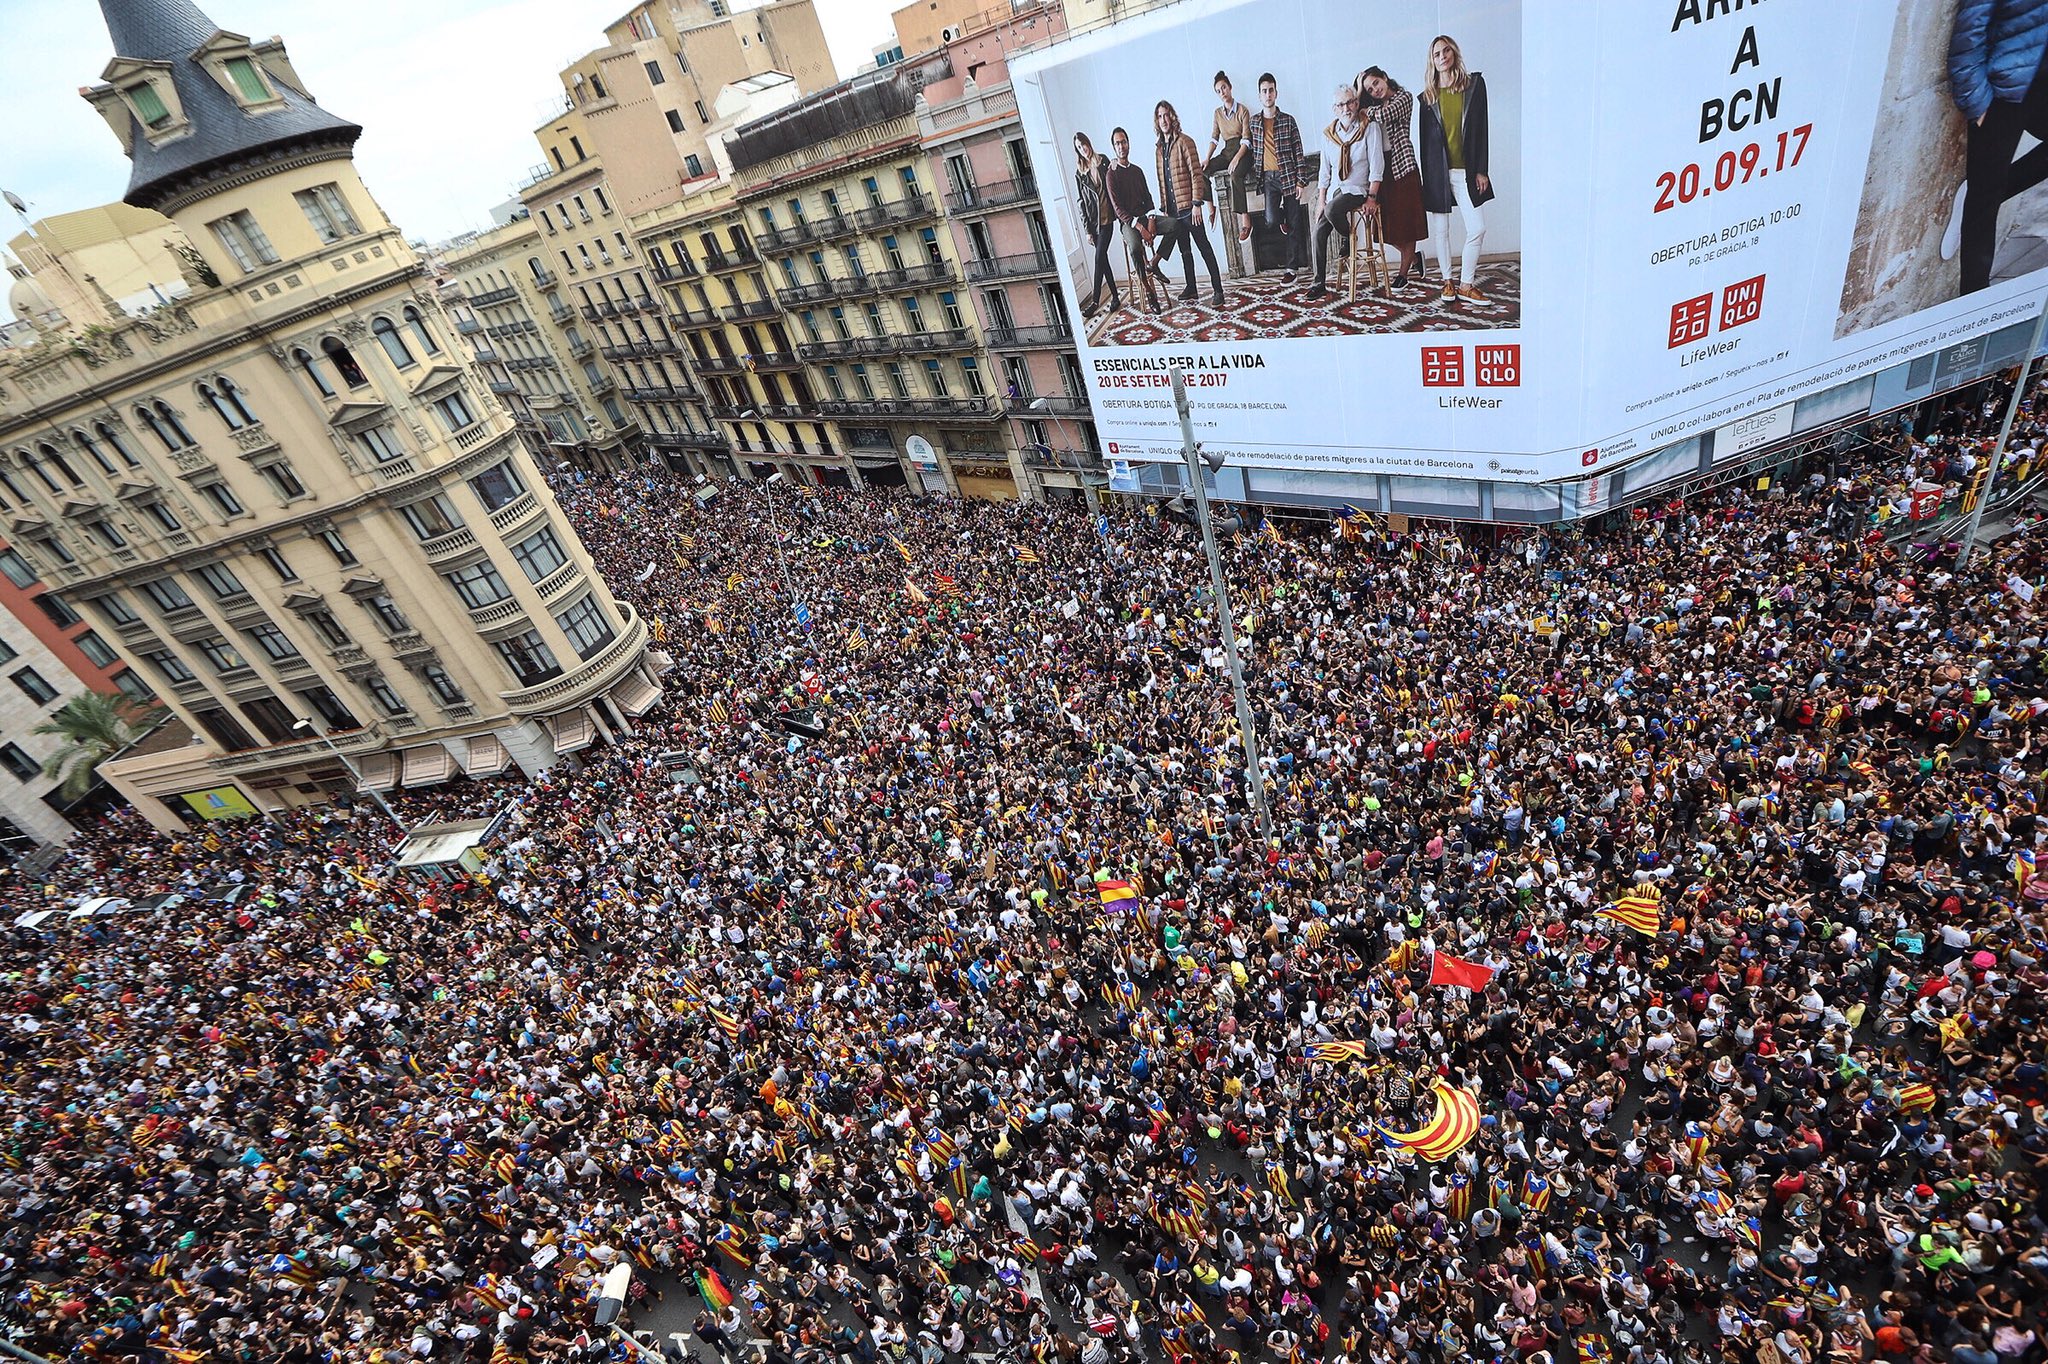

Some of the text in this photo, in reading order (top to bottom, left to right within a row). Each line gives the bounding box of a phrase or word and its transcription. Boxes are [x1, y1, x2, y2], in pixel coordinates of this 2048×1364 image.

[1730, 25, 1760, 75] A
[1699, 76, 1782, 143] BCN
[1653, 123, 1813, 213] 20.09.17
[1651, 203, 1801, 265] OBERTURA BOTIGA 10:00
[1704, 250, 1714, 262] DE
[1751, 236, 1759, 246] 18
[510, 271, 539, 315] HOTEL
[1726, 282, 1757, 306] UNI
[1724, 301, 1757, 326] QLO
[1094, 354, 1266, 372] ESSENCIALS PER A LA VIDA
[1427, 351, 1458, 365] ユニ
[1480, 350, 1512, 365] UNI
[1681, 337, 1741, 367] LifeWear
[541, 325, 591, 411] INGLATERRA
[1427, 368, 1459, 382] クロ
[1480, 367, 1515, 384] QLO
[1650, 421, 1686, 441] UNIQLO
[1733, 402, 1745, 412] en
[1746, 396, 1755, 407] el
[1756, 392, 1772, 404] Pla
[1773, 386, 1785, 398] de
[1786, 366, 1844, 393] remodelació
[1845, 362, 1857, 374] de
[1858, 350, 1888, 374] parets
[1888, 338, 1929, 360] mitgeres
[1930, 335, 1938, 343] a
[1938, 330, 1947, 341] la
[1948, 321, 1976, 337] ciutat
[1976, 317, 1989, 328] de
[1990, 299, 2036, 324] Barcelona
[1097, 373, 1228, 388] 20 DE SETEMRE 2017
[1625, 398, 1653, 414] Compra
[1654, 391, 1675, 404] online
[1681, 376, 1719, 394] uniqlo.com
[1725, 358, 1768, 379] Segueix-nos
[1102, 400, 1142, 409] OBERTURA
[1143, 400, 1173, 409] BOTIGA
[1439, 396, 1503, 408] LifeWear
[1731, 412, 1777, 437] lefties
[1148, 447, 1173, 455] UNIQLO
[1600, 437, 1634, 454] Ajuntament
[1600, 443, 1637, 460] de Barcelona
[1247, 452, 1292, 460] remodelació
[1293, 453, 1304, 461] de
[1304, 455, 1330, 464] parets
[1331, 455, 1368, 465] mitgeres
[1376, 456, 1384, 464] la
[1386, 457, 1412, 466] ciutat
[1413, 458, 1425, 466] de
[1427, 458, 1474, 469] Barcelona
